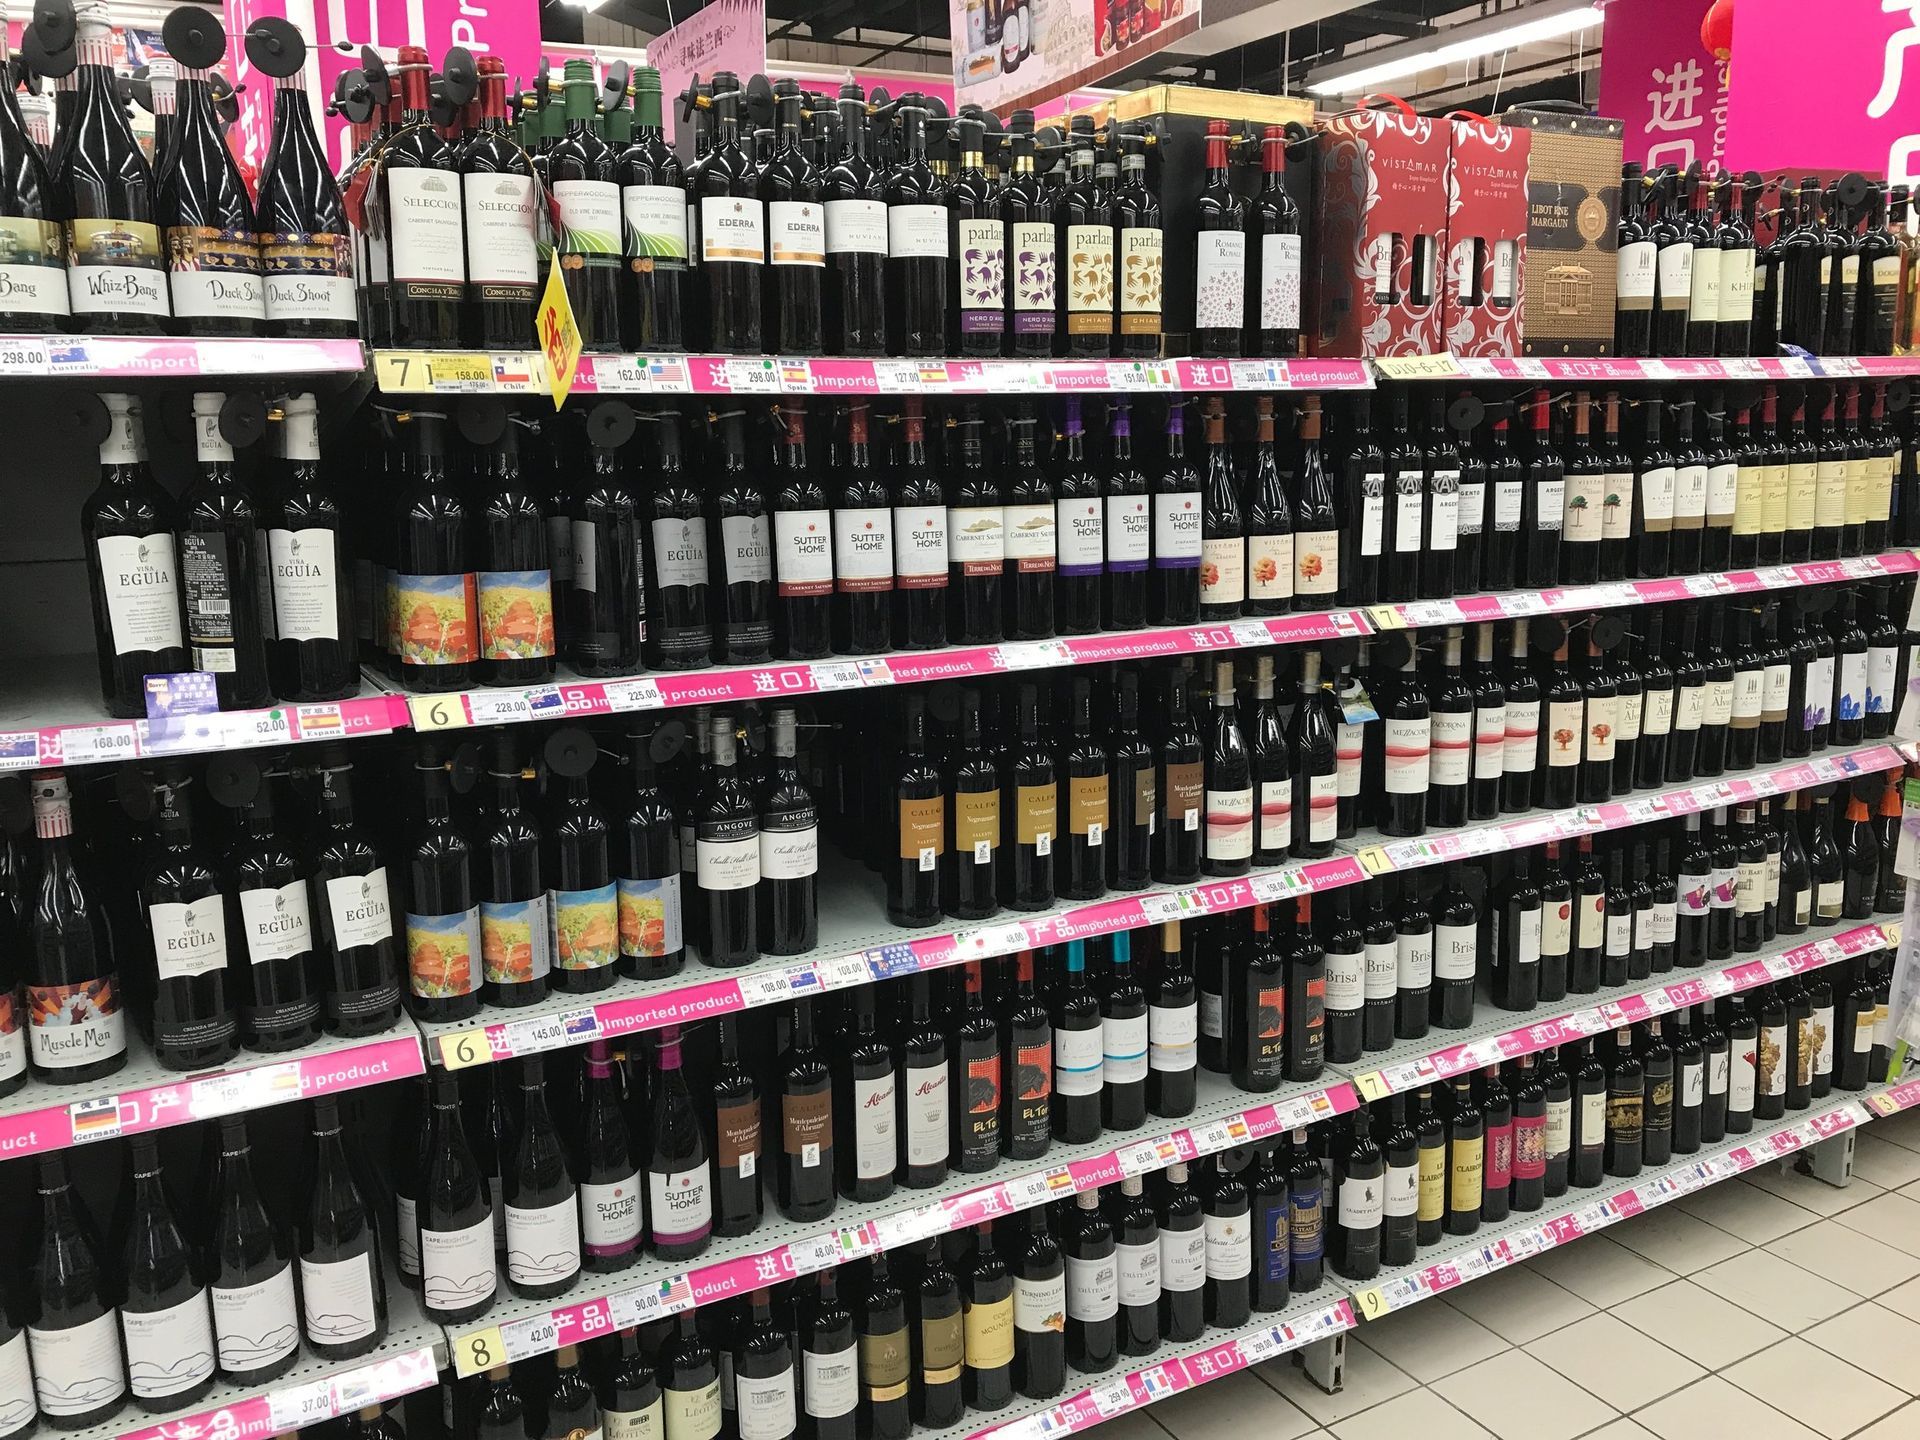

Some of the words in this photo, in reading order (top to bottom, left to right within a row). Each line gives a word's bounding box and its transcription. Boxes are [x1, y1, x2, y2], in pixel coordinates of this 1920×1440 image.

[403, 197, 458, 211] SELECCION
[478, 200, 532, 215] SELECCION
[719, 218, 755, 229] EDERRA
[787, 222, 821, 233] EDERRA
[1531, 217, 1568, 228] MARGAUN
[207, 280, 242, 301] Duck
[269, 284, 295, 304] Duck
[297, 283, 331, 303] Shoot
[2, 352, 43, 365] 298.00
[51, 363, 98, 373] Australia
[390, 359, 410, 387] 7
[455, 370, 485, 382] 158.00
[617, 370, 647, 383] 162.00
[748, 369, 776, 383] 298.00
[894, 371, 920, 384] 127.00
[1124, 372, 1145, 383] 151.00
[1191, 365, 1230, 386] 进口
[1320, 370, 1360, 388] product
[503, 384, 525, 393] Chile
[661, 384, 679, 392] USA
[787, 384, 807, 394] Spain
[1169, 512, 1200, 522] SUTTER
[1077, 527, 1101, 537] HOME
[1126, 524, 1148, 533] HOME
[1173, 521, 1199, 531] HOME
[793, 535, 827, 545] SUTTER
[850, 533, 885, 543] SUTTER
[912, 530, 944, 540] SUTTER
[798, 544, 825, 554] HOME
[855, 541, 883, 551] HOME
[916, 539, 942, 548] HOME
[288, 558, 305, 566] VIÑA
[667, 549, 704, 562] EGUÍA
[136, 565, 154, 574] VIÑA
[278, 562, 322, 578] EGUÍA
[119, 570, 169, 587] EGUÍA
[1379, 610, 1394, 626] 7
[1273, 626, 1315, 641] mported
[1078, 644, 1133, 662] Imported
[1136, 640, 1178, 657] product
[921, 660, 974, 679] product
[833, 671, 859, 683] 108.00
[628, 689, 658, 702] 225.00
[671, 684, 733, 703] product
[429, 702, 449, 726] 6
[495, 700, 527, 714] 228.00
[256, 719, 285, 734] 52.00
[93, 734, 131, 750] 168.00
[0, 757, 40, 771] ustralia
[781, 810, 814, 823] ANGOVE
[716, 820, 752, 833] ANGOVE
[1366, 853, 1380, 869] 7
[1315, 869, 1357, 888] product
[345, 902, 386, 922] EGUÍA
[1652, 913, 1674, 923] Brisa
[258, 917, 303, 935] EGUÍA
[1074, 911, 1123, 936] Imported
[167, 931, 216, 951] EGUÍA
[1888, 928, 1898, 943] 6
[1451, 940, 1475, 954] Bris
[837, 963, 863, 977] 108.00
[1367, 959, 1396, 973] Brisa
[1326, 969, 1358, 983] Brisa
[761, 979, 787, 994] 108.00
[605, 1004, 677, 1030] Imported
[680, 991, 741, 1019] product
[531, 1026, 561, 1040] 145.00
[40, 1031, 82, 1055] Muscle
[84, 1027, 111, 1048] Man
[457, 1037, 475, 1064] 6
[315, 1060, 390, 1089] product
[1365, 1077, 1378, 1095] 7
[1293, 1106, 1310, 1119] 65.00
[74, 1126, 121, 1142] Germany
[1208, 1130, 1225, 1143] 65.00
[1136, 1151, 1154, 1165] 65.00
[664, 1185, 704, 1202] SUTTER
[1027, 1181, 1046, 1195] 65.00
[597, 1195, 637, 1214] SUTTER
[669, 1195, 702, 1211] HOME
[602, 1206, 634, 1222] HOME
[814, 1244, 836, 1259] 48.00
[1020, 1289, 1048, 1301] TURNING
[635, 1294, 658, 1311] 90.00
[670, 1302, 687, 1312] USA
[1366, 1292, 1378, 1313] 9
[530, 1325, 554, 1343] 42.00
[470, 1337, 491, 1367] 8
[302, 1394, 330, 1413] 37.00
